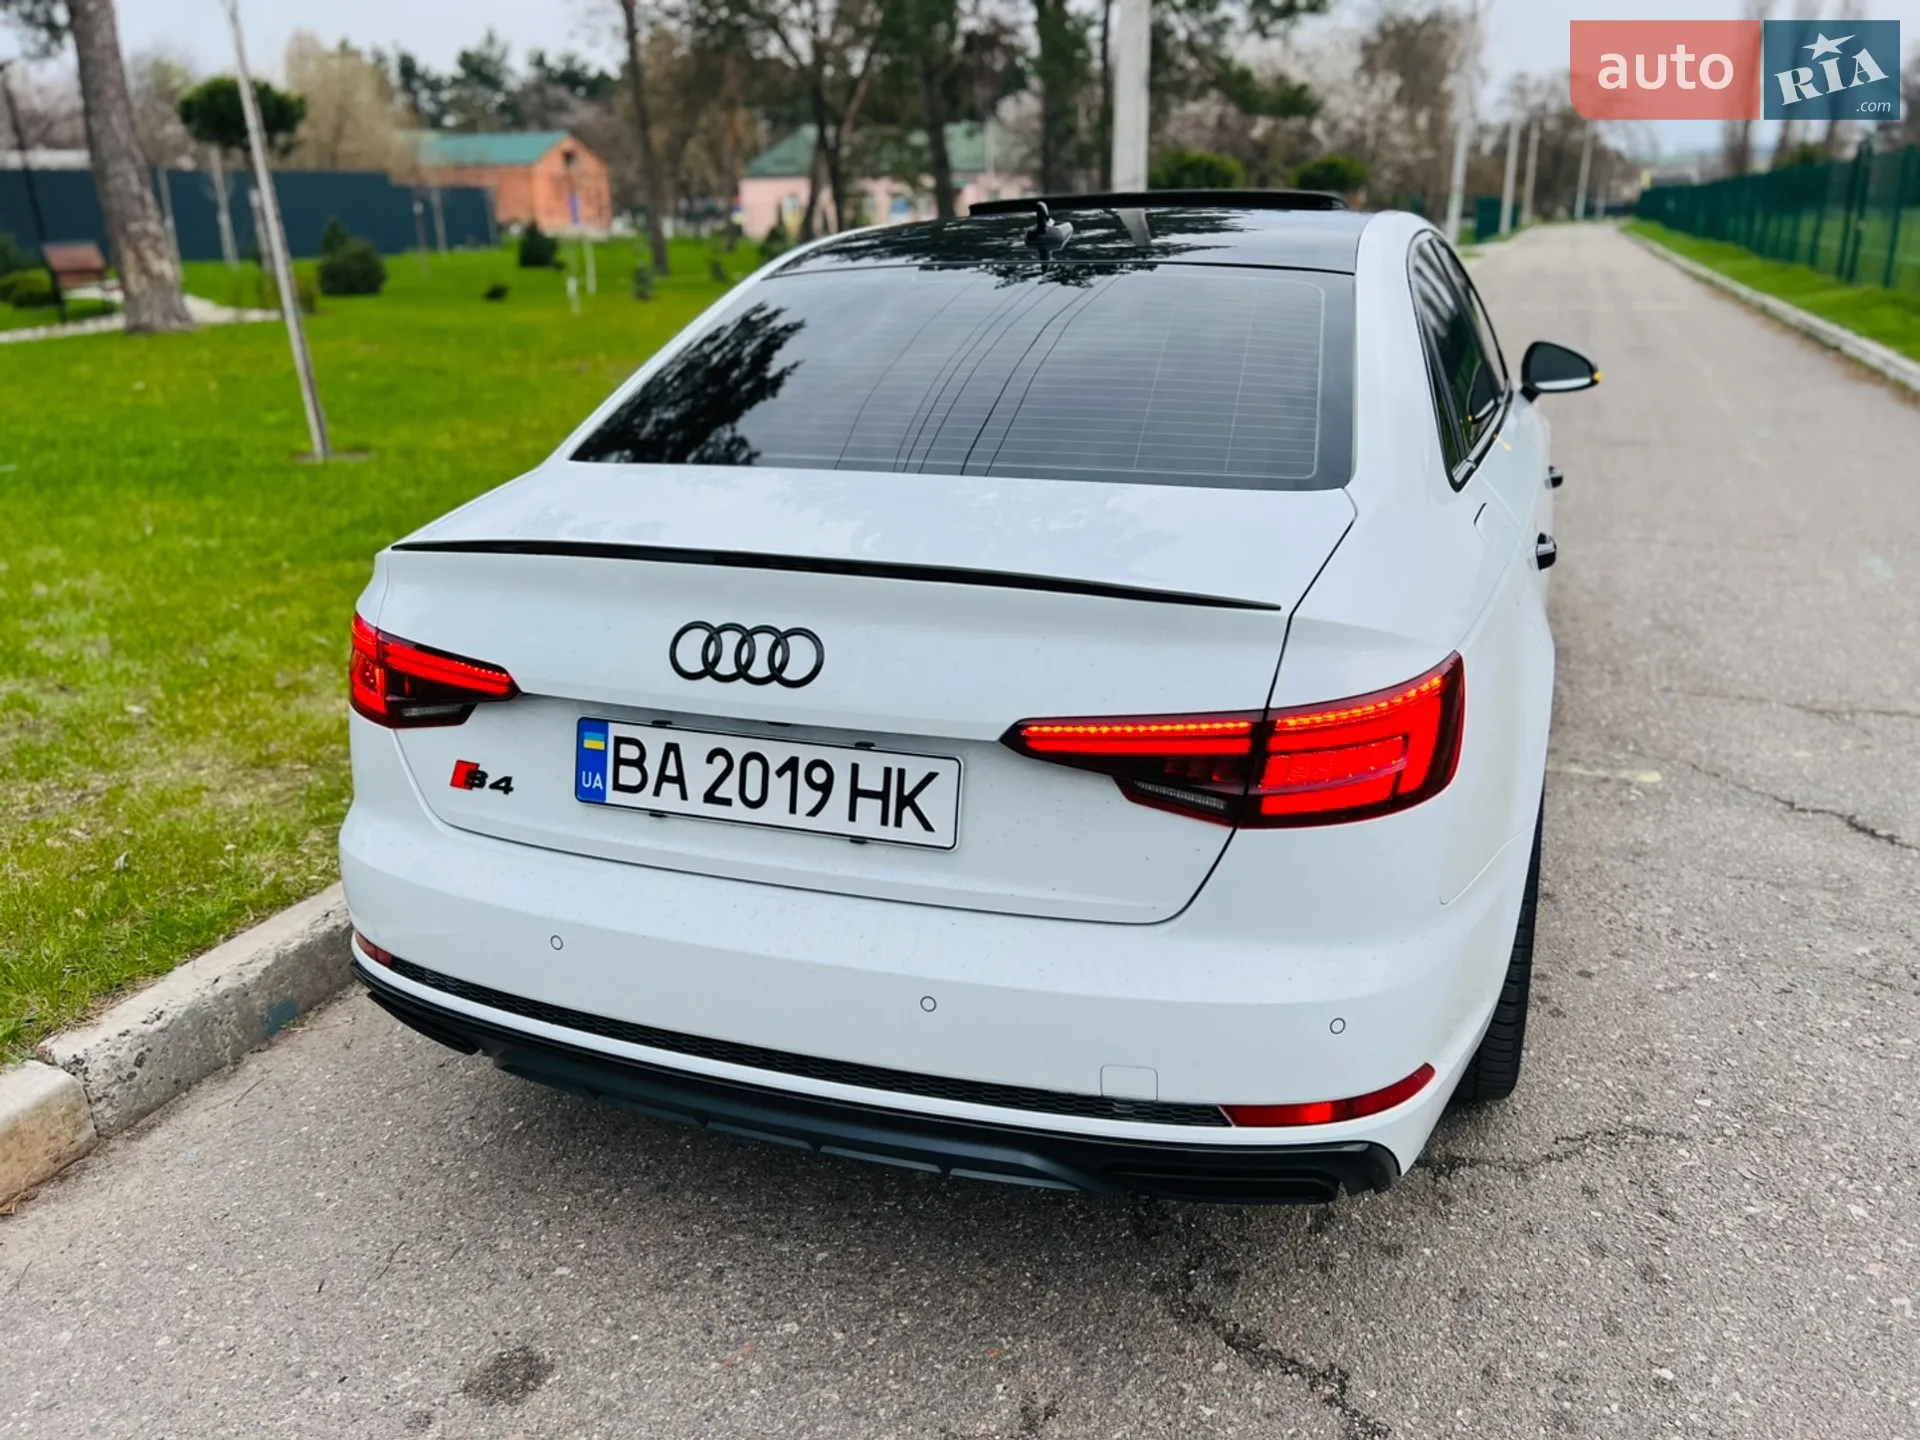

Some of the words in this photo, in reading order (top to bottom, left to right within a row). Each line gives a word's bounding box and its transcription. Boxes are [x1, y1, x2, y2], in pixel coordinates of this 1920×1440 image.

[581, 770, 604, 790] UA
[611, 735, 689, 801] BA
[702, 747, 834, 817] 2019
[847, 761, 940, 833] HK
